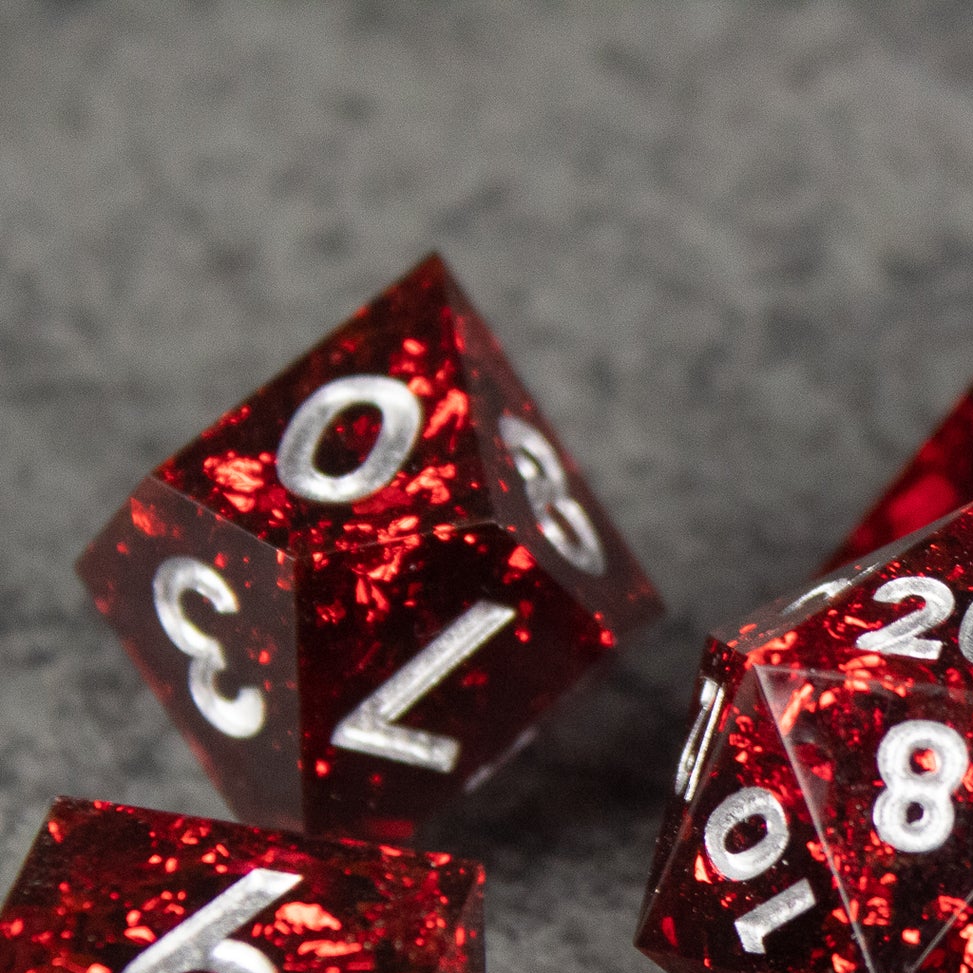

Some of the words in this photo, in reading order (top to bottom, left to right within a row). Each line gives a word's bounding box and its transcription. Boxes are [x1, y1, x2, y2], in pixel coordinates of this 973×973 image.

[276, 374, 423, 503] 0
[153, 556, 267, 738] 3
[331, 600, 516, 773] 7
[704, 786, 816, 954] 10
[873, 720, 968, 853] 8
